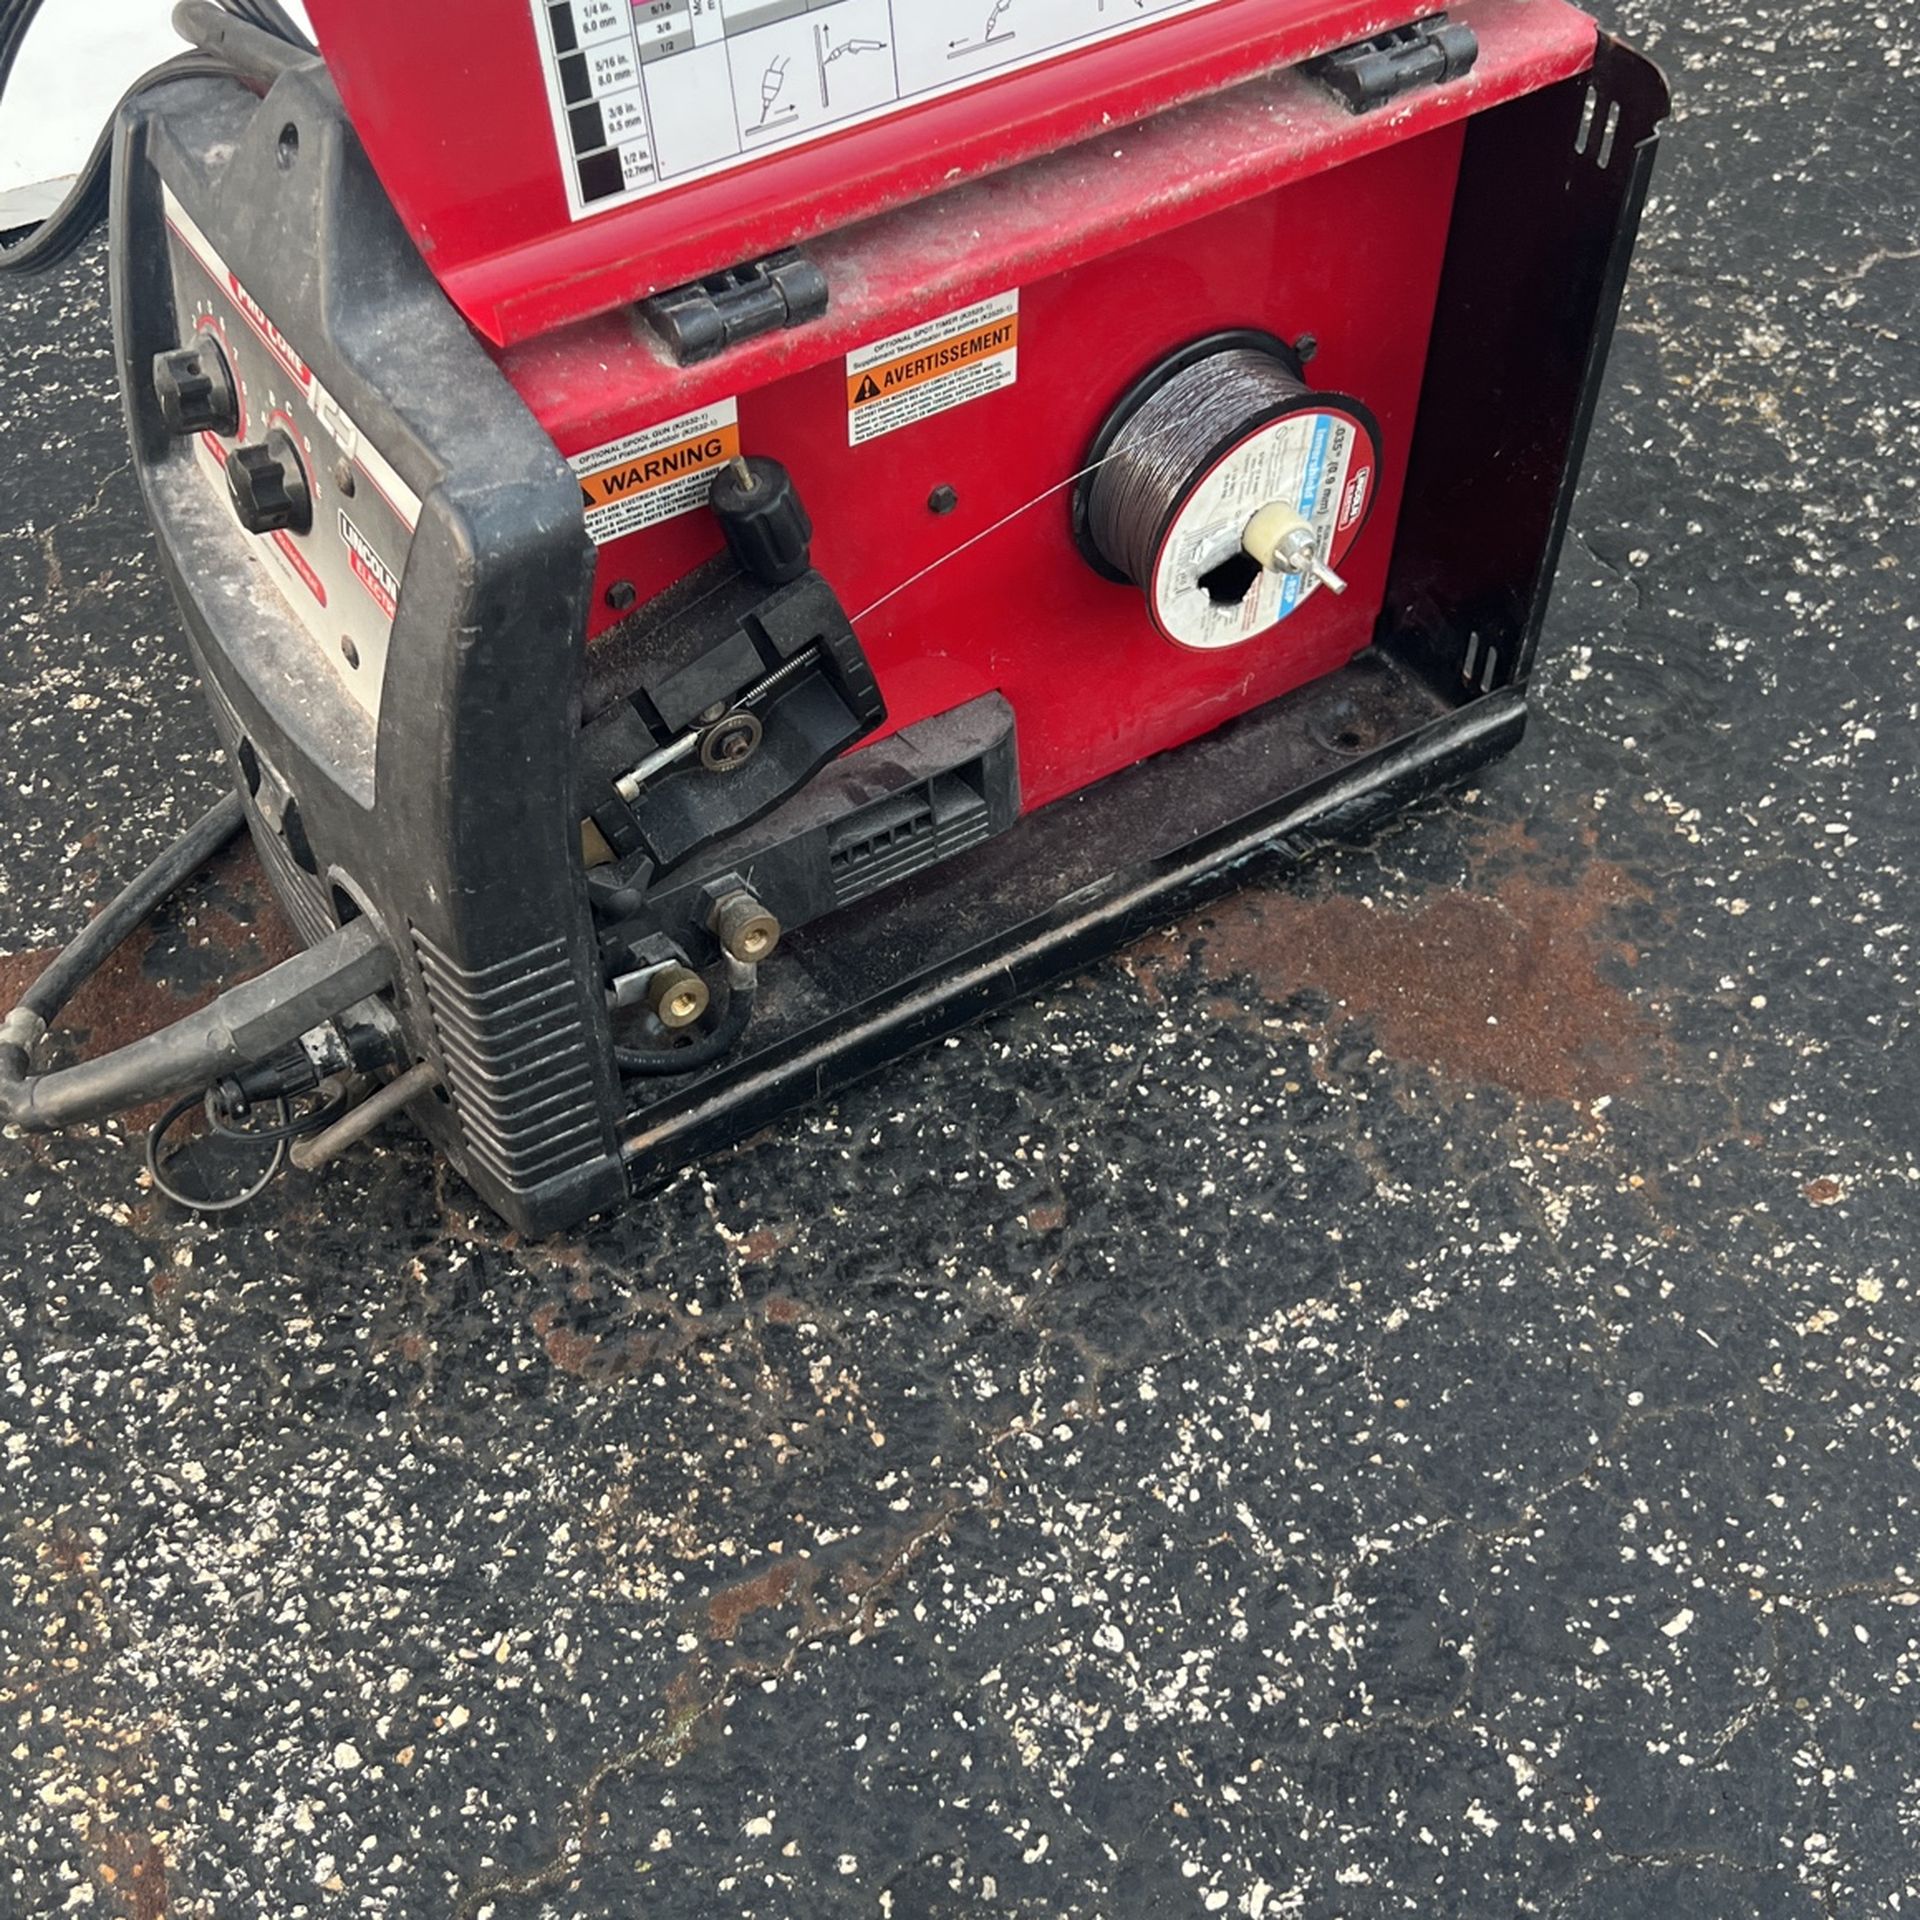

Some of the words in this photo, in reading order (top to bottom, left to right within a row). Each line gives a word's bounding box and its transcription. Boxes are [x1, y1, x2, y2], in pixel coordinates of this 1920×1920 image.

[583, 3, 598, 18] 1/4
[600, 1, 613, 12] in.
[582, 19, 598, 34] 6.0
[599, 16, 617, 28] mm
[656, 21, 672, 34] 3/8
[660, 41, 675, 53] 1/2
[595, 57, 616, 72] 5/16
[617, 54, 629, 65] in.
[598, 73, 613, 86] 8.0
[608, 105, 624, 119] 3/8
[625, 102, 637, 113] in.
[624, 115, 642, 128] mm
[623, 152, 638, 166] 1/2
[639, 149, 649, 160] in.
[623, 163, 655, 179] 12.7mm
[874, 335, 913, 353] OPTIONAL
[913, 327, 934, 338] SPOT
[935, 317, 959, 330] TIMER
[883, 324, 1013, 388] AVERTISSEMENT
[578, 445, 621, 465] OPTIONAL
[622, 434, 650, 449] SPOOL
[652, 426, 671, 439] GUN
[602, 438, 722, 495] WARNING
[1304, 427, 1328, 500] Innershield
[1325, 461, 1339, 485] (0.9
[586, 509, 606, 520] PARTS
[607, 503, 620, 513] AND
[621, 490, 657, 507] ELECTRICAL
[659, 481, 686, 494] CONTACT
[1317, 488, 1331, 515] mm)
[342, 517, 398, 603] LINCOLN
